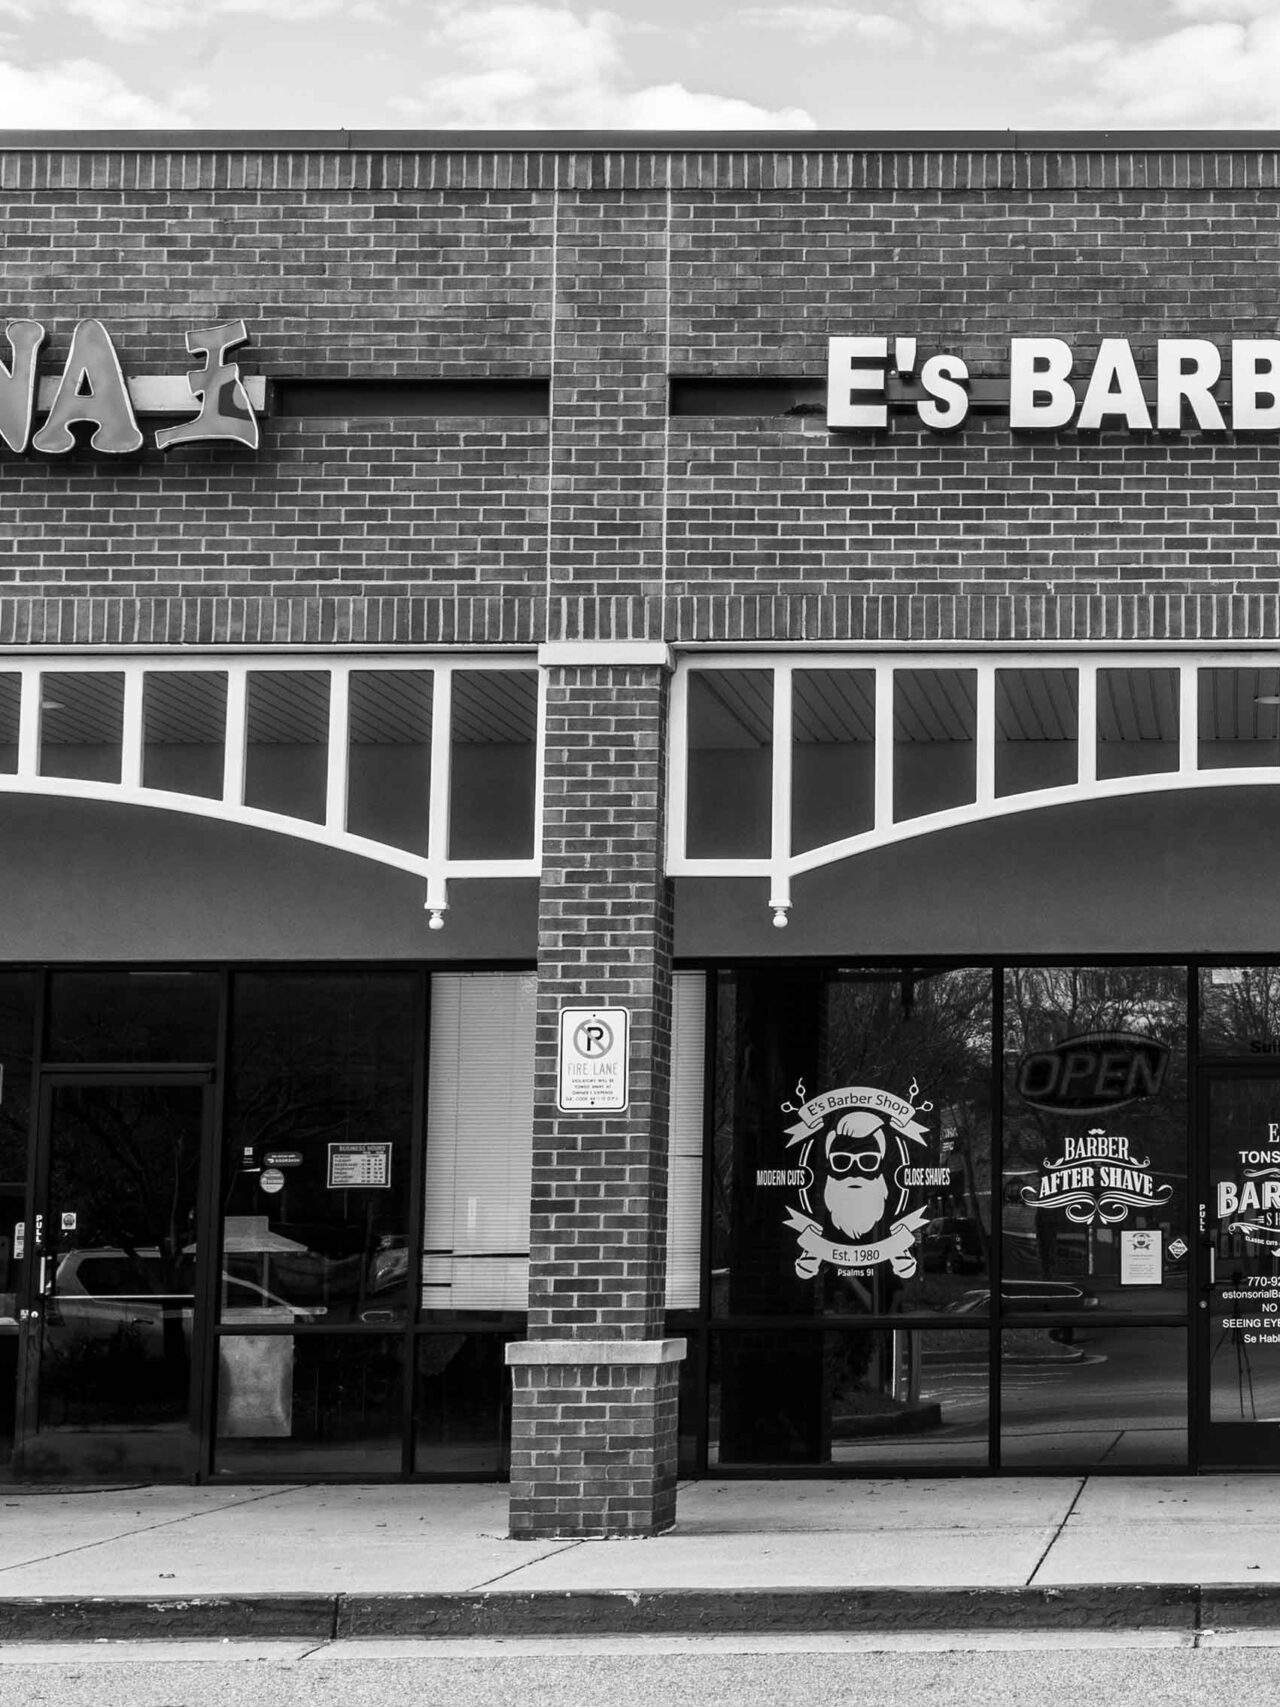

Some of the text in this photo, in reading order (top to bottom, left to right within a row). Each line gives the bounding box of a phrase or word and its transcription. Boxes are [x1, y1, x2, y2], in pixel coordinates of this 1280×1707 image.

[826, 337, 970, 434] E's
[568, 1062, 619, 1076] FIRE LANE
[1020, 1052, 1168, 1096] OPEN
[807, 1093, 910, 1116] E's Barber Shop
[1064, 1137, 1129, 1161] BARBER
[756, 1169, 806, 1186] MODERN CUTS
[904, 1167, 950, 1186] CLOSE SHAVES
[1039, 1166, 1153, 1199] AFTER SHAVE
[1245, 1235, 1265, 1245] CLASSIC
[832, 1249, 879, 1262] Est. 1980
[837, 1268, 874, 1277] Psalms 91
[1262, 1303, 1278, 1312] NO
[1222, 1318, 1261, 1328] SEEING
[1244, 1334, 1257, 1343] Se
